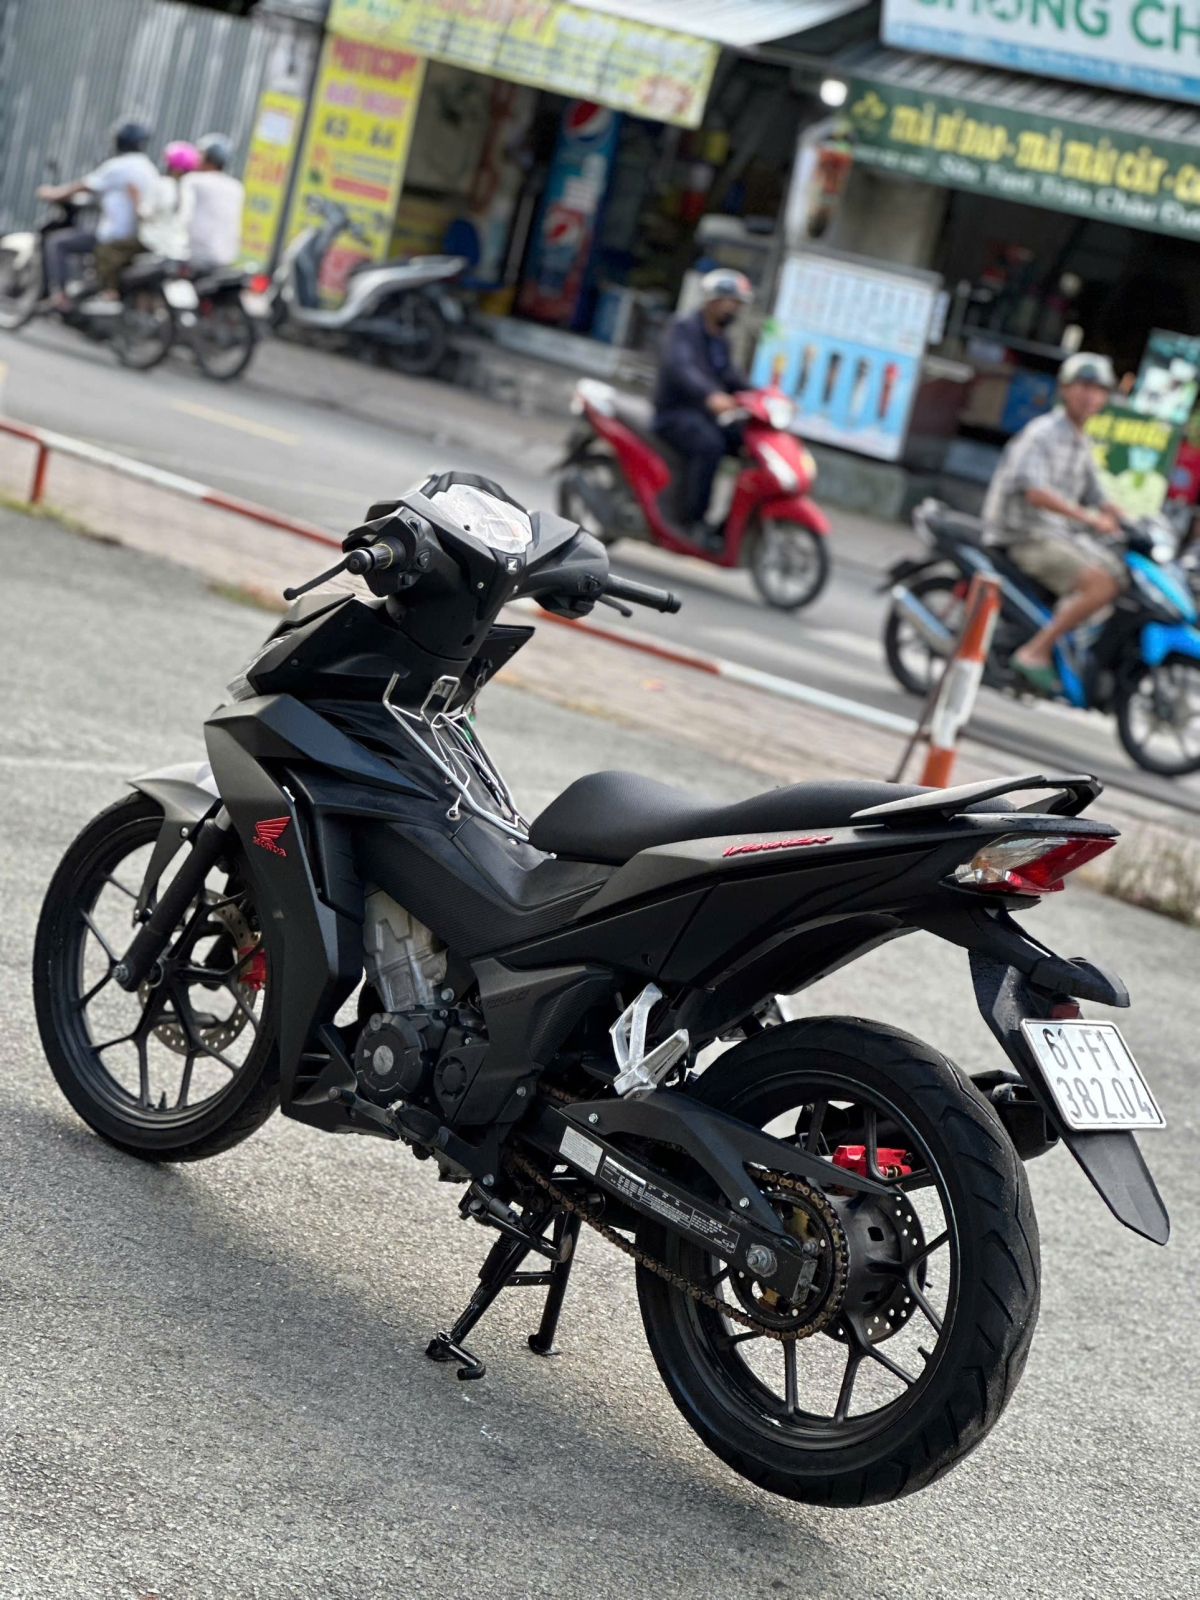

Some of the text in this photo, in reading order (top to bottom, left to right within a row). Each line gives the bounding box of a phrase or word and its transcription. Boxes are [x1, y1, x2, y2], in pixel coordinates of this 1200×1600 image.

[252, 836, 287, 857] HONDA
[1042, 1027, 1121, 1071] 61-F1
[1056, 1076, 1155, 1120] 382.04
